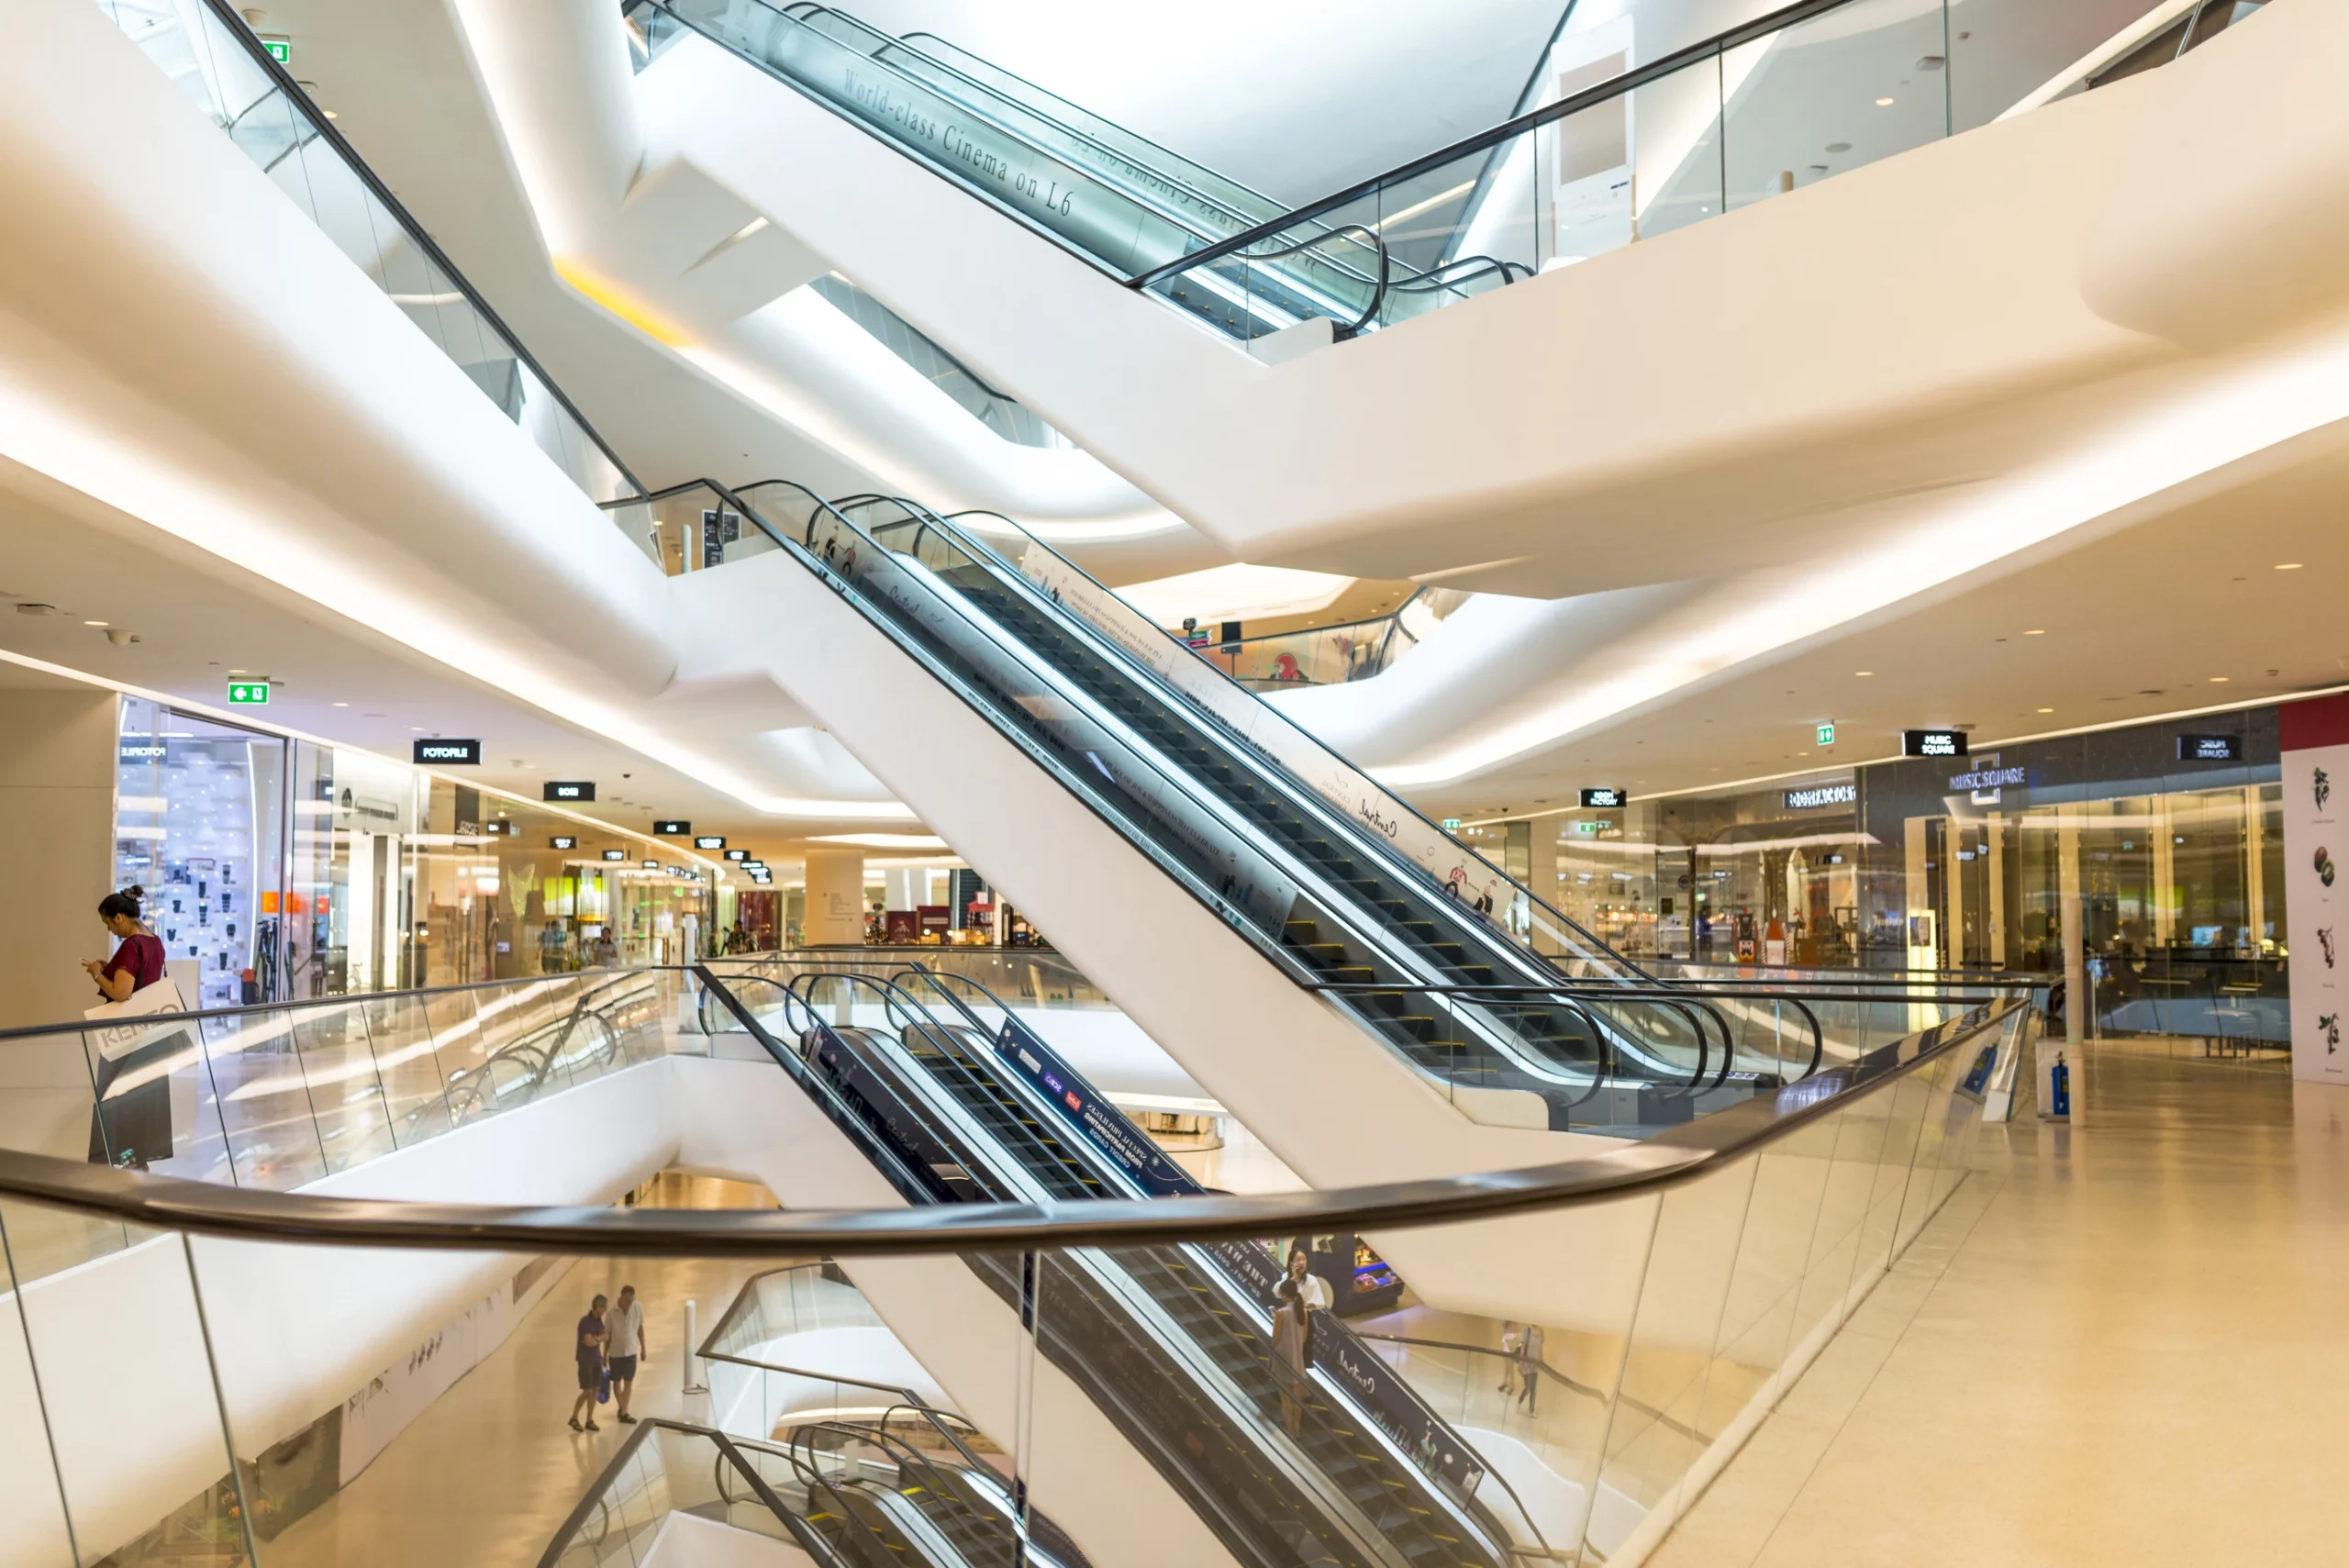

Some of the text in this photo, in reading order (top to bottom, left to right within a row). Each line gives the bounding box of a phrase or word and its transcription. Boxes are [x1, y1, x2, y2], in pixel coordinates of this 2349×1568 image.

[845, 69, 1074, 217] World-class Cinema on L6
[1925, 736, 1952, 745] MUSIC
[423, 747, 469, 758] FOTOFILE
[1921, 745, 1955, 755] SQUARE
[1949, 766, 2025, 791] MUSIC SQUARE
[1590, 797, 1618, 806] FACTORY
